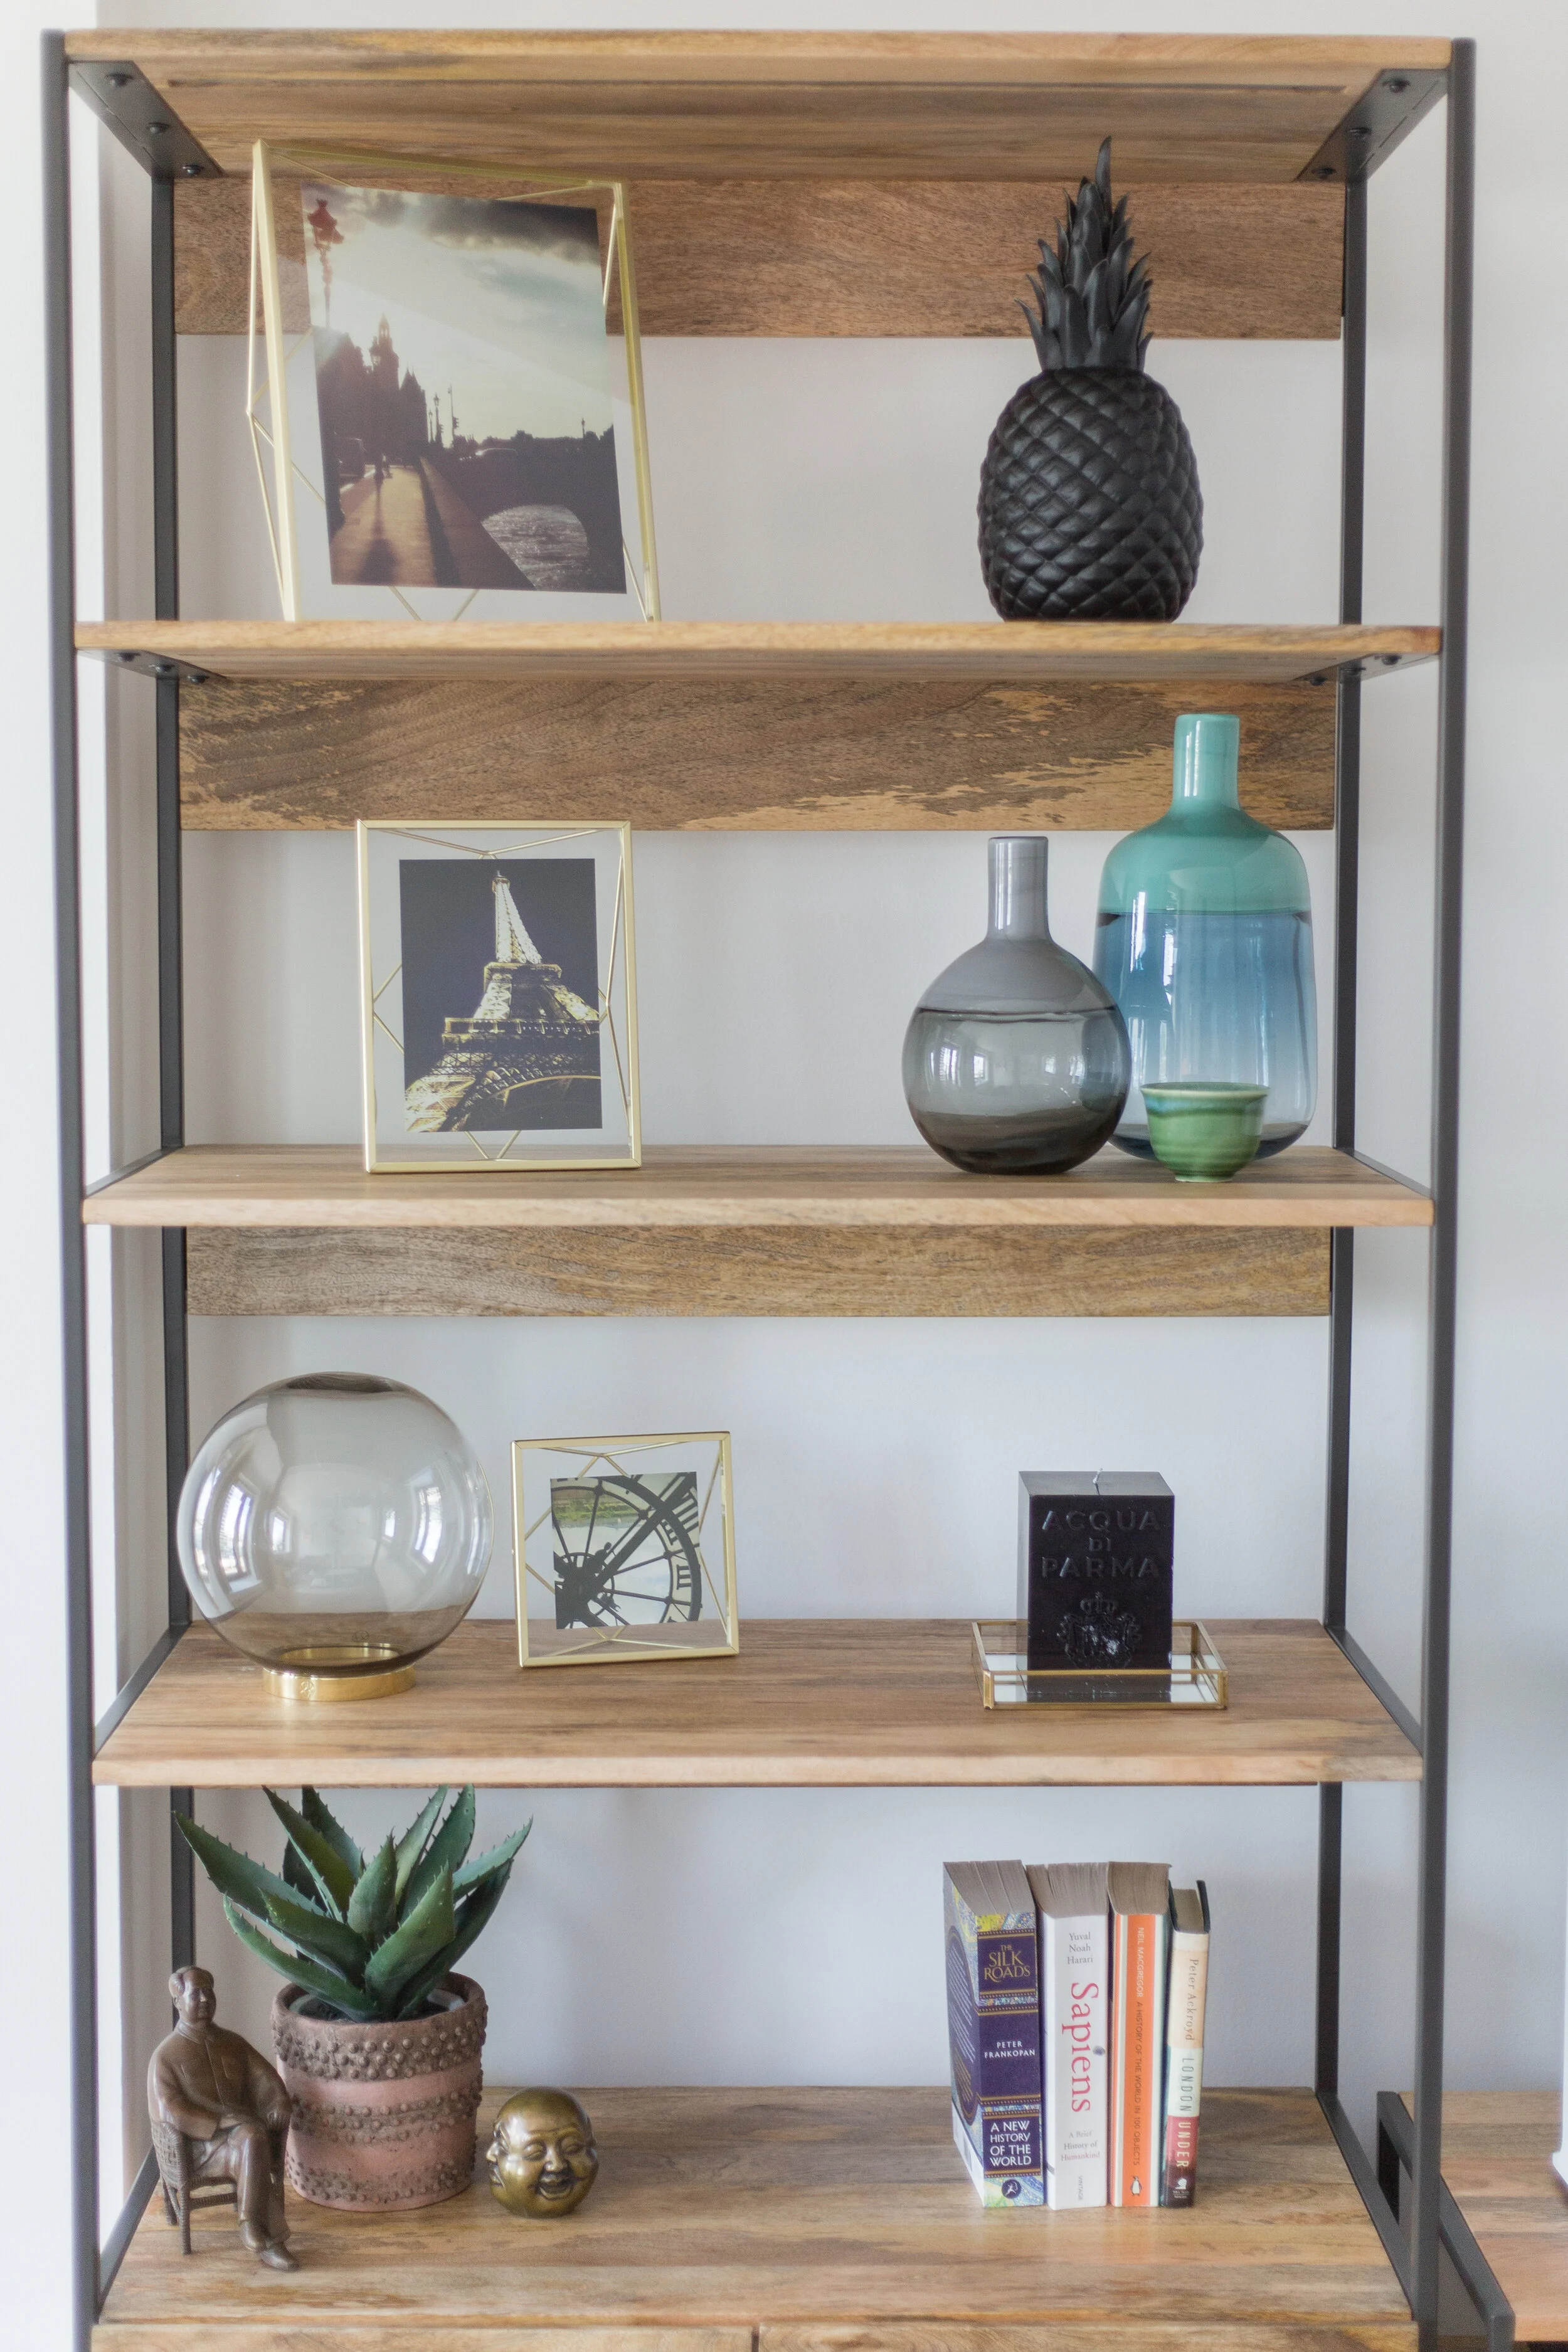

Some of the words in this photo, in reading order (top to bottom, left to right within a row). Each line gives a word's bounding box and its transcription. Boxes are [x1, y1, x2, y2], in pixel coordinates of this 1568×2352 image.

[1042, 1510, 1161, 1532] ACQUA
[1042, 1556, 1160, 1578] PARMA
[1069, 1932, 1091, 1941] Yuval
[1069, 1944, 1091, 1952] Noah
[988, 1951, 1024, 1967] SILK
[1066, 1955, 1093, 1964] Harari
[984, 1965, 1031, 1983] ROADS
[1187, 1959, 1199, 1989] Peter
[1184, 1993, 1197, 2040] Ackroyd
[997, 2041, 1022, 2049] PETER
[1062, 1983, 1099, 2112] Sapiens
[1135, 2045, 1142, 2056] OF
[984, 2049, 1035, 2058] FRANKOPAN
[1180, 2058, 1194, 2111] LONDON
[1134, 2105, 1140, 2114] IN
[990, 2122, 1000, 2132] A
[1004, 2121, 1030, 2131] NEW
[990, 2132, 1030, 2143] HISTORY
[990, 2146, 1005, 2156] OF
[1009, 2144, 1031, 2154] THE
[1064, 2143, 1088, 2151] History
[1177, 2122, 1191, 2168] UNDER
[990, 2156, 1031, 2167] WORLD
[1061, 2151, 1100, 2161] Humankind
